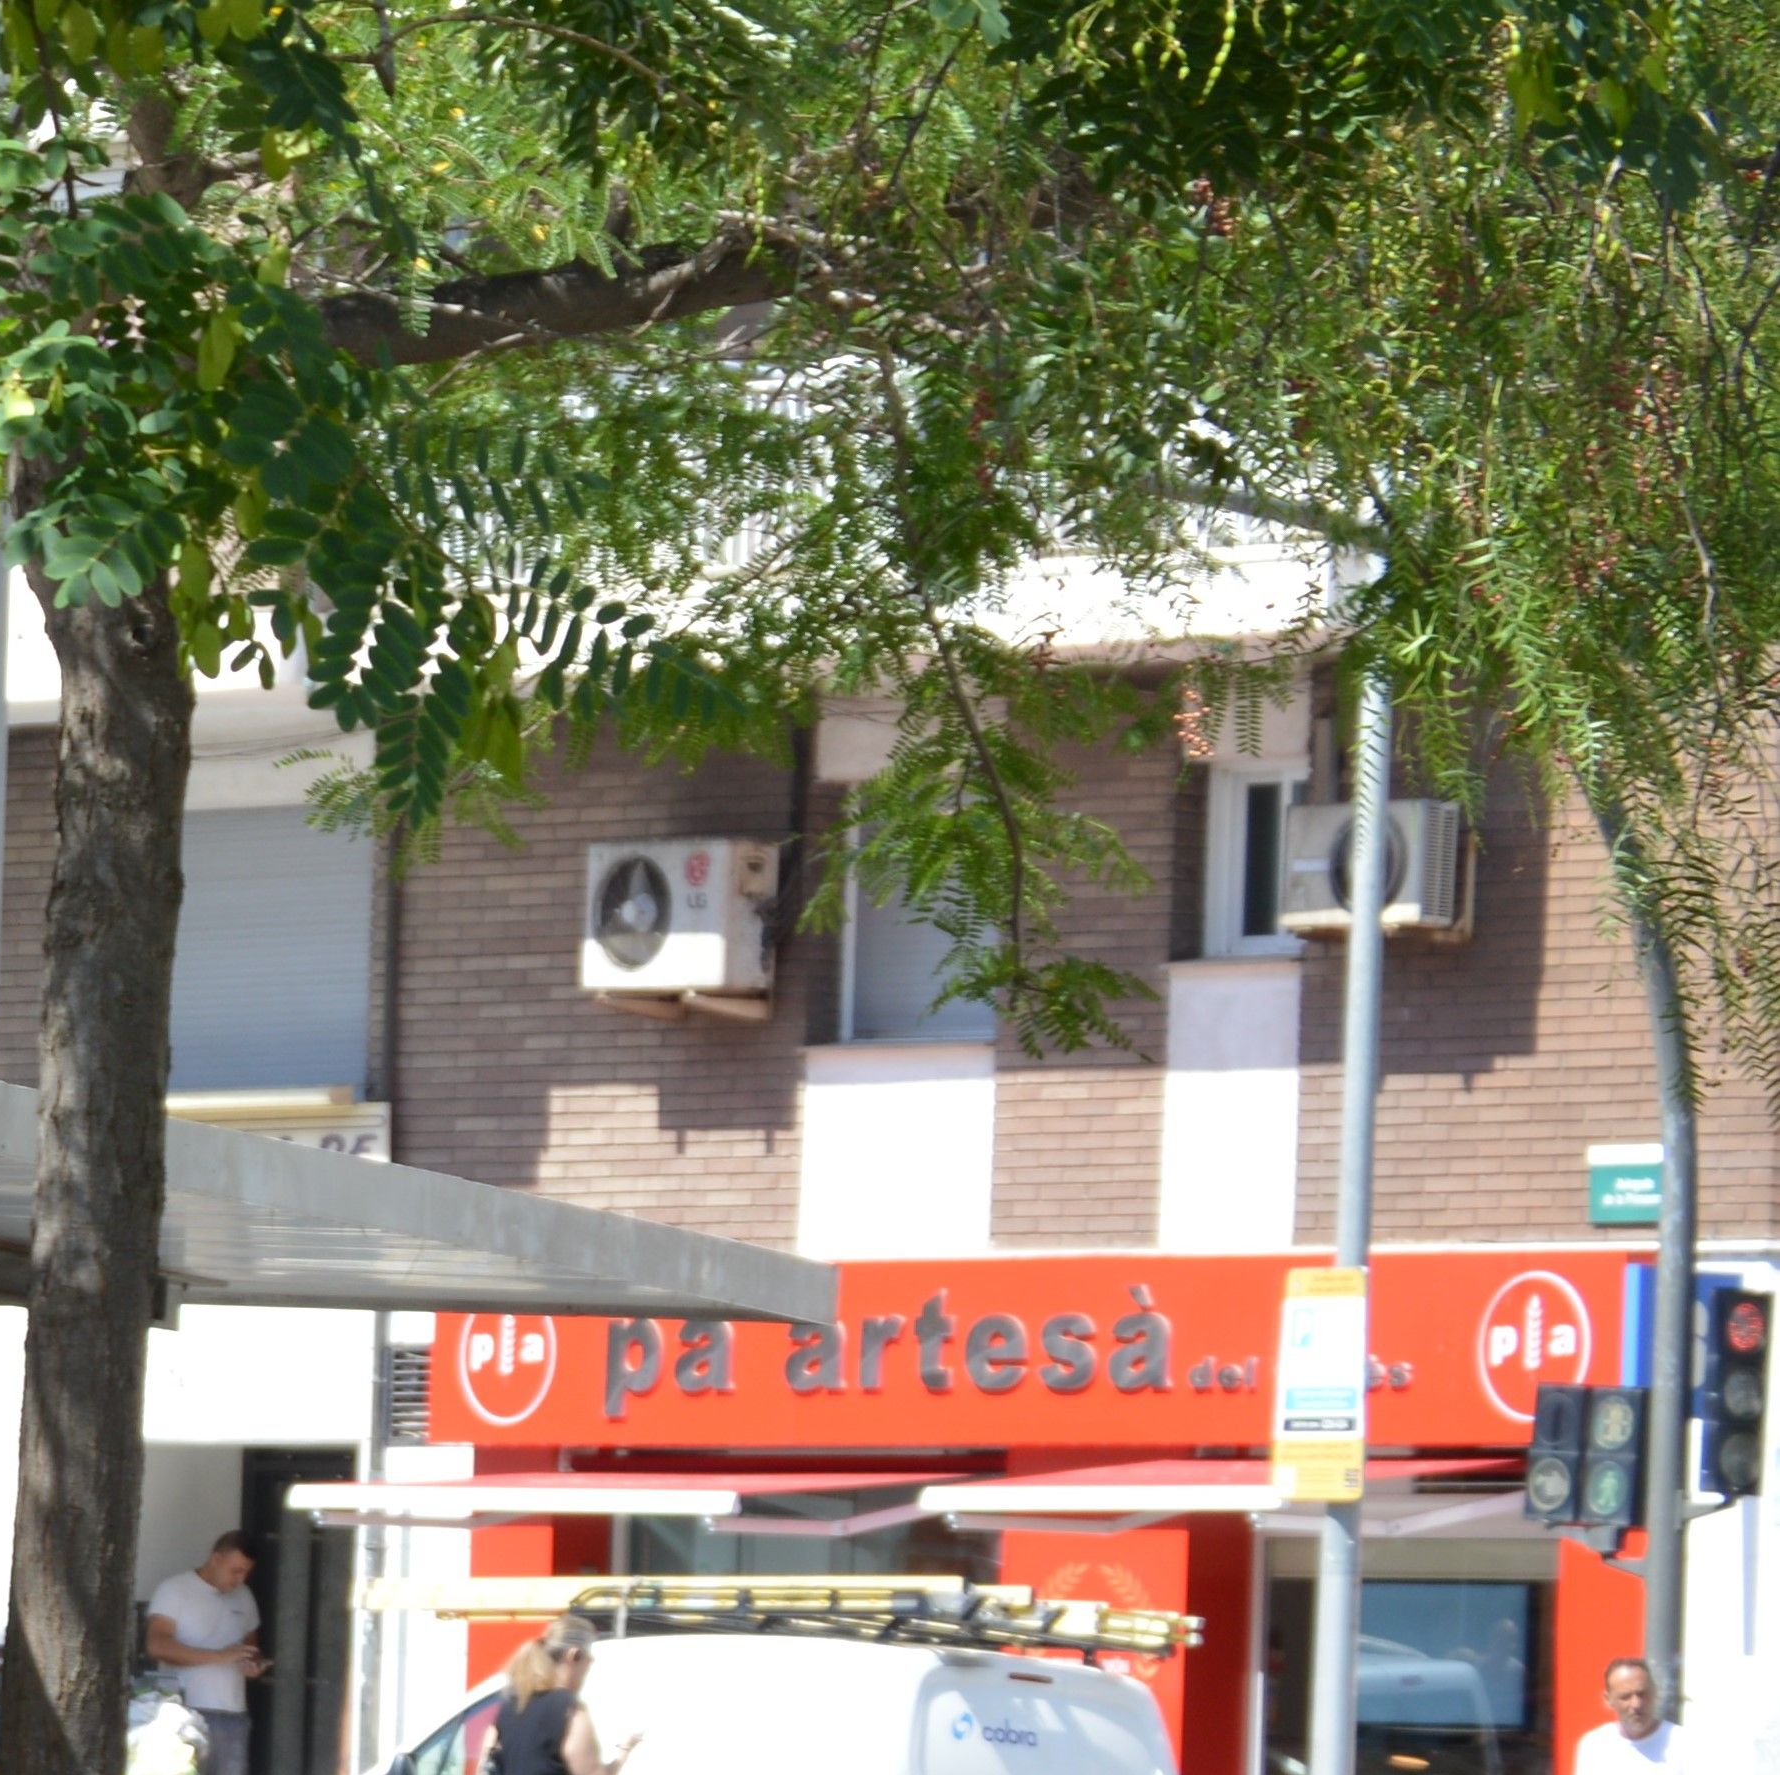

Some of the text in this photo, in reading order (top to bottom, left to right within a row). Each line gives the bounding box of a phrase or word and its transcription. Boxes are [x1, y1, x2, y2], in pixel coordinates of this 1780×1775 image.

[603, 1285, 1260, 1421] pa artesà del
[981, 1718, 1039, 1747] cobra
